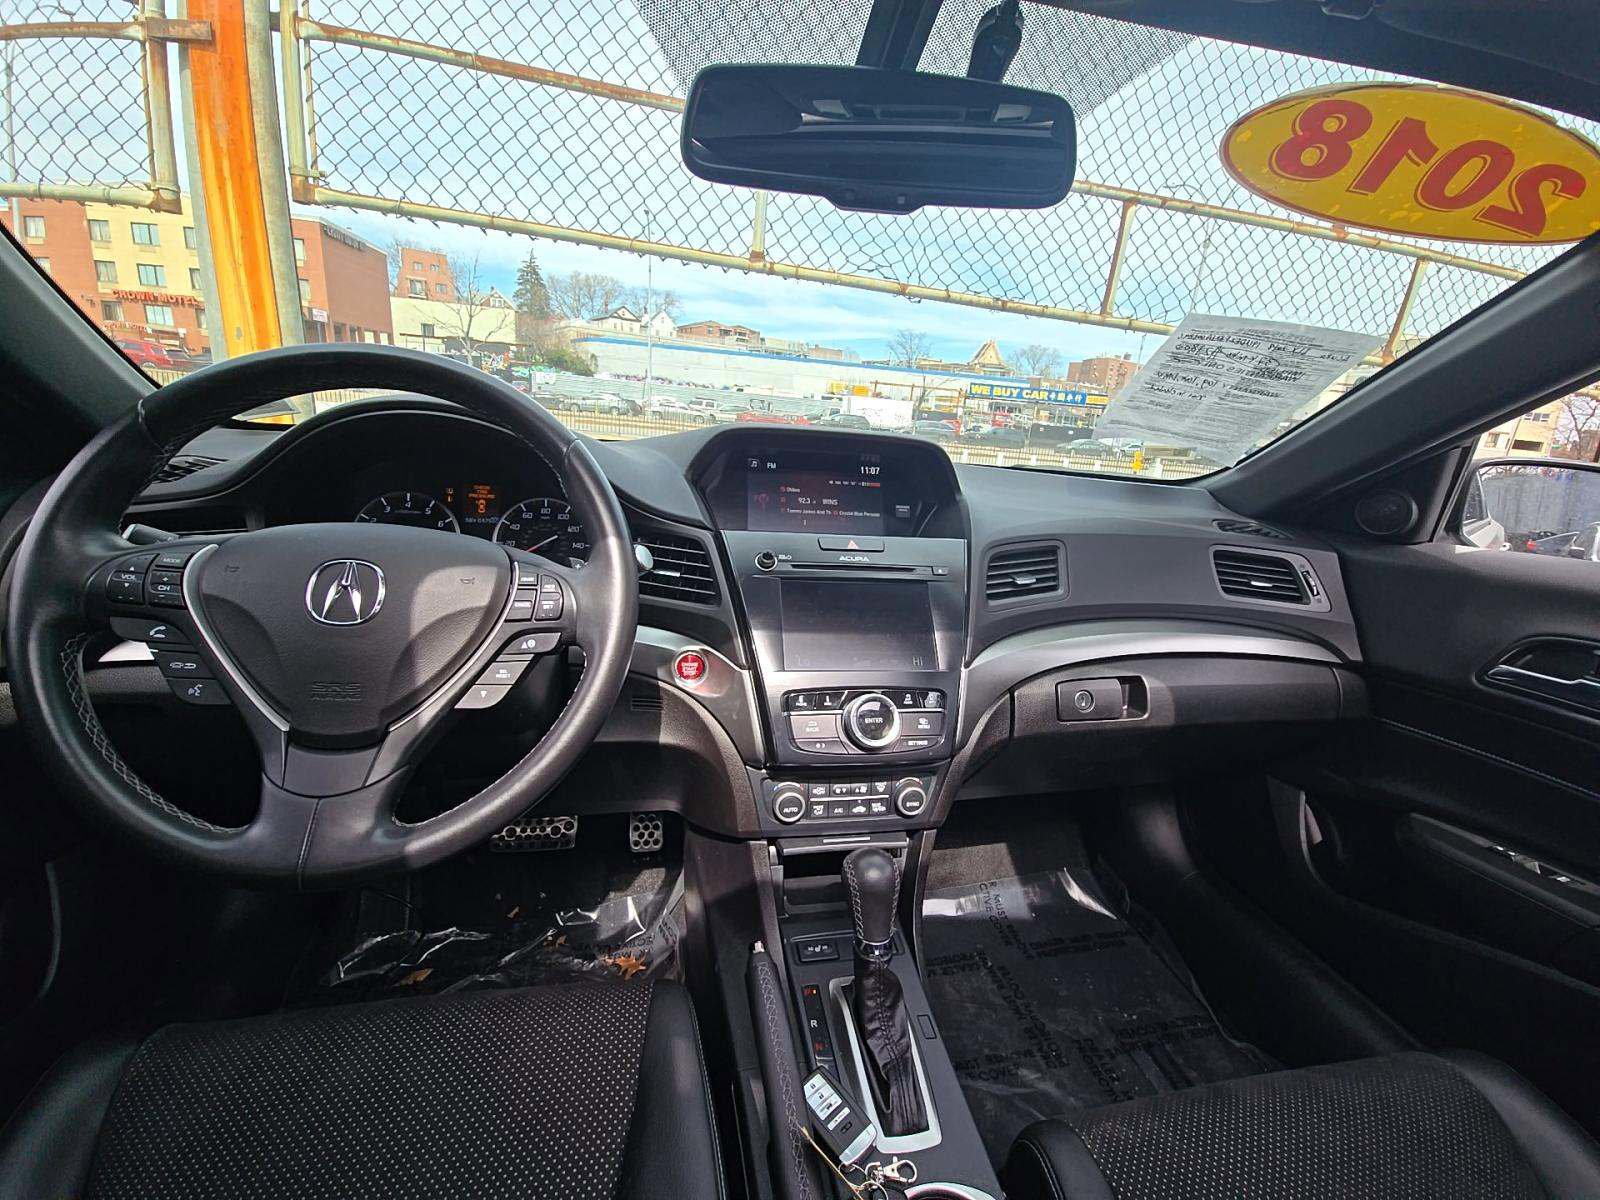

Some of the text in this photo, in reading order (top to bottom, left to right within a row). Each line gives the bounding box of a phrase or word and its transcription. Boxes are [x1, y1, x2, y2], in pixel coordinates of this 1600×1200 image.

[112, 288, 202, 306] CROWN MOTEL
[971, 384, 990, 396] WE
[993, 386, 1019, 397] BUY
[1022, 389, 1048, 401] CAR
[860, 466, 880, 475] 11:07
[425, 507, 432, 515] 5
[510, 523, 520, 531] 40
[912, 656, 924, 667] HI
[810, 1020, 818, 1028] R
